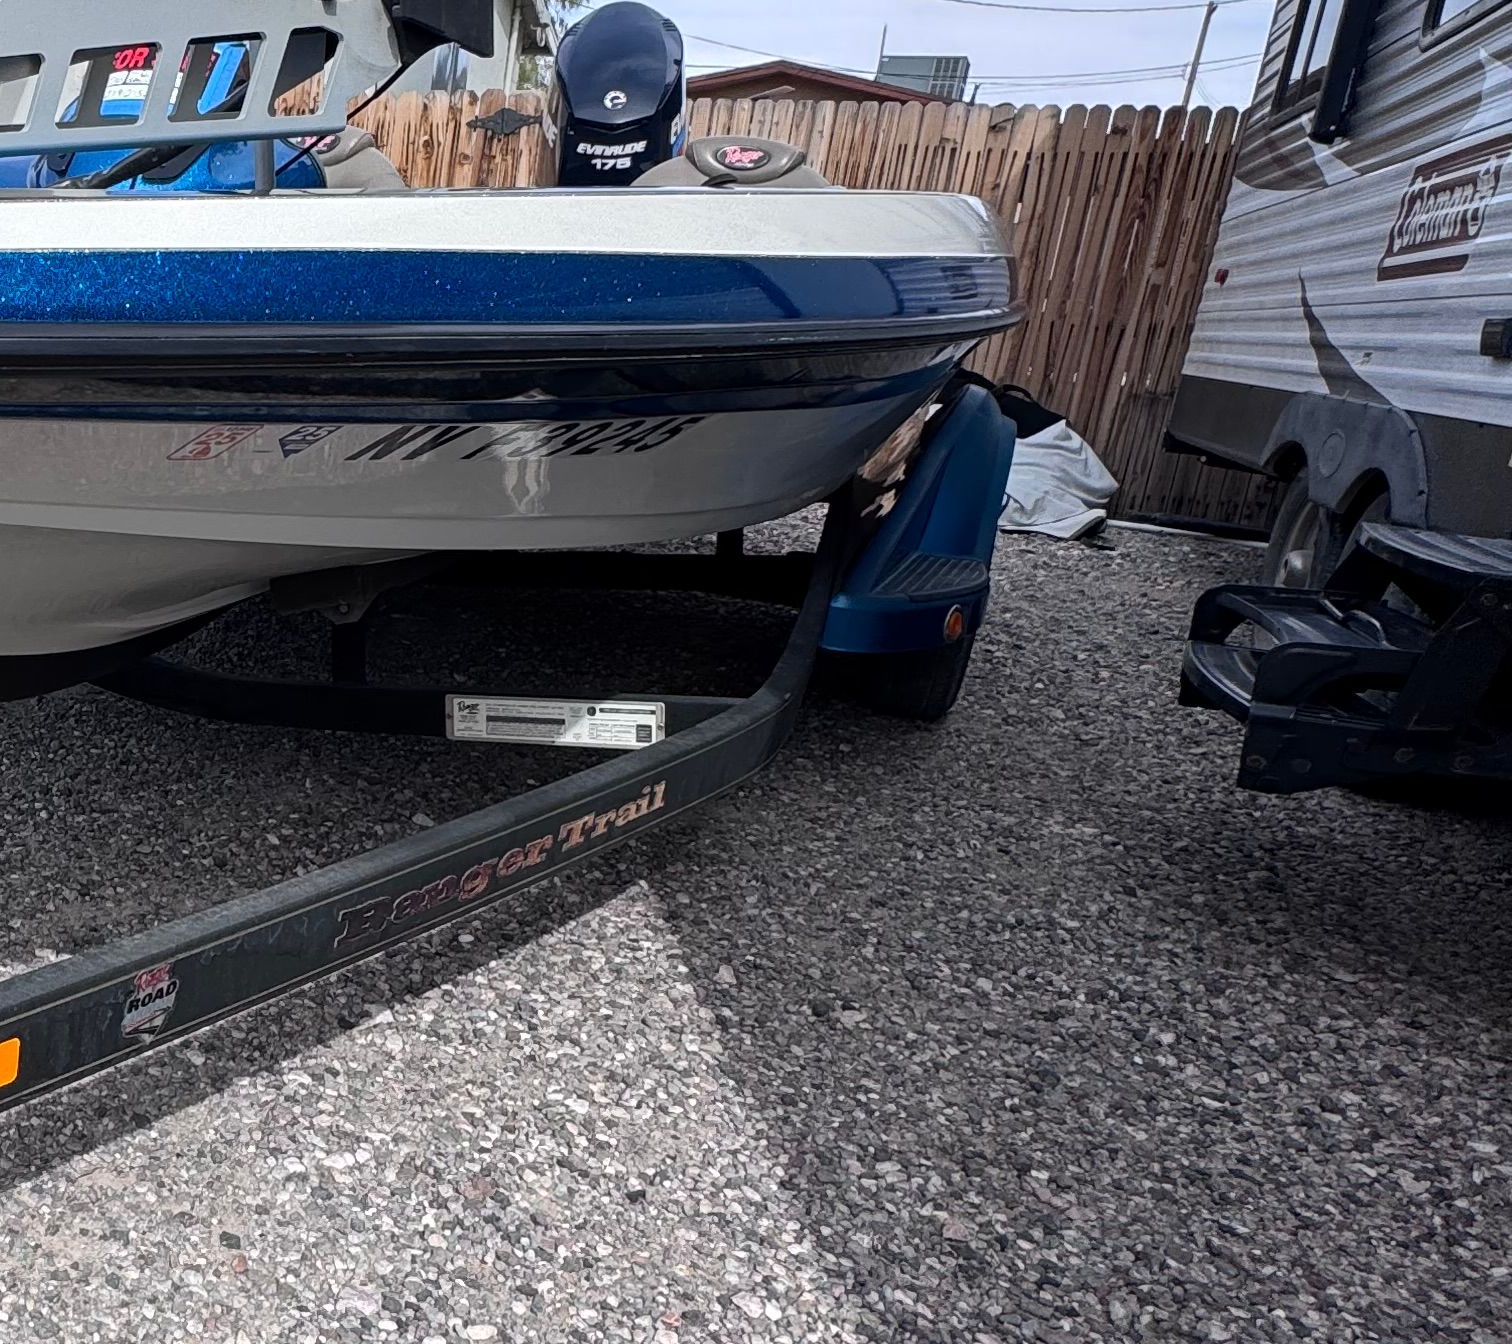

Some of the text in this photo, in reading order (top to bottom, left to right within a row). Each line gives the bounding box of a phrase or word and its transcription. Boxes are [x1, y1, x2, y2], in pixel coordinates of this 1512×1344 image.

[113, 47, 150, 70] OR
[576, 140, 648, 156] EVINRUDE
[1392, 172, 1475, 254] Coleman
[286, 425, 334, 441] 25
[345, 424, 484, 461] NV
[558, 780, 668, 853] Trail
[126, 979, 178, 1015] ROAD
